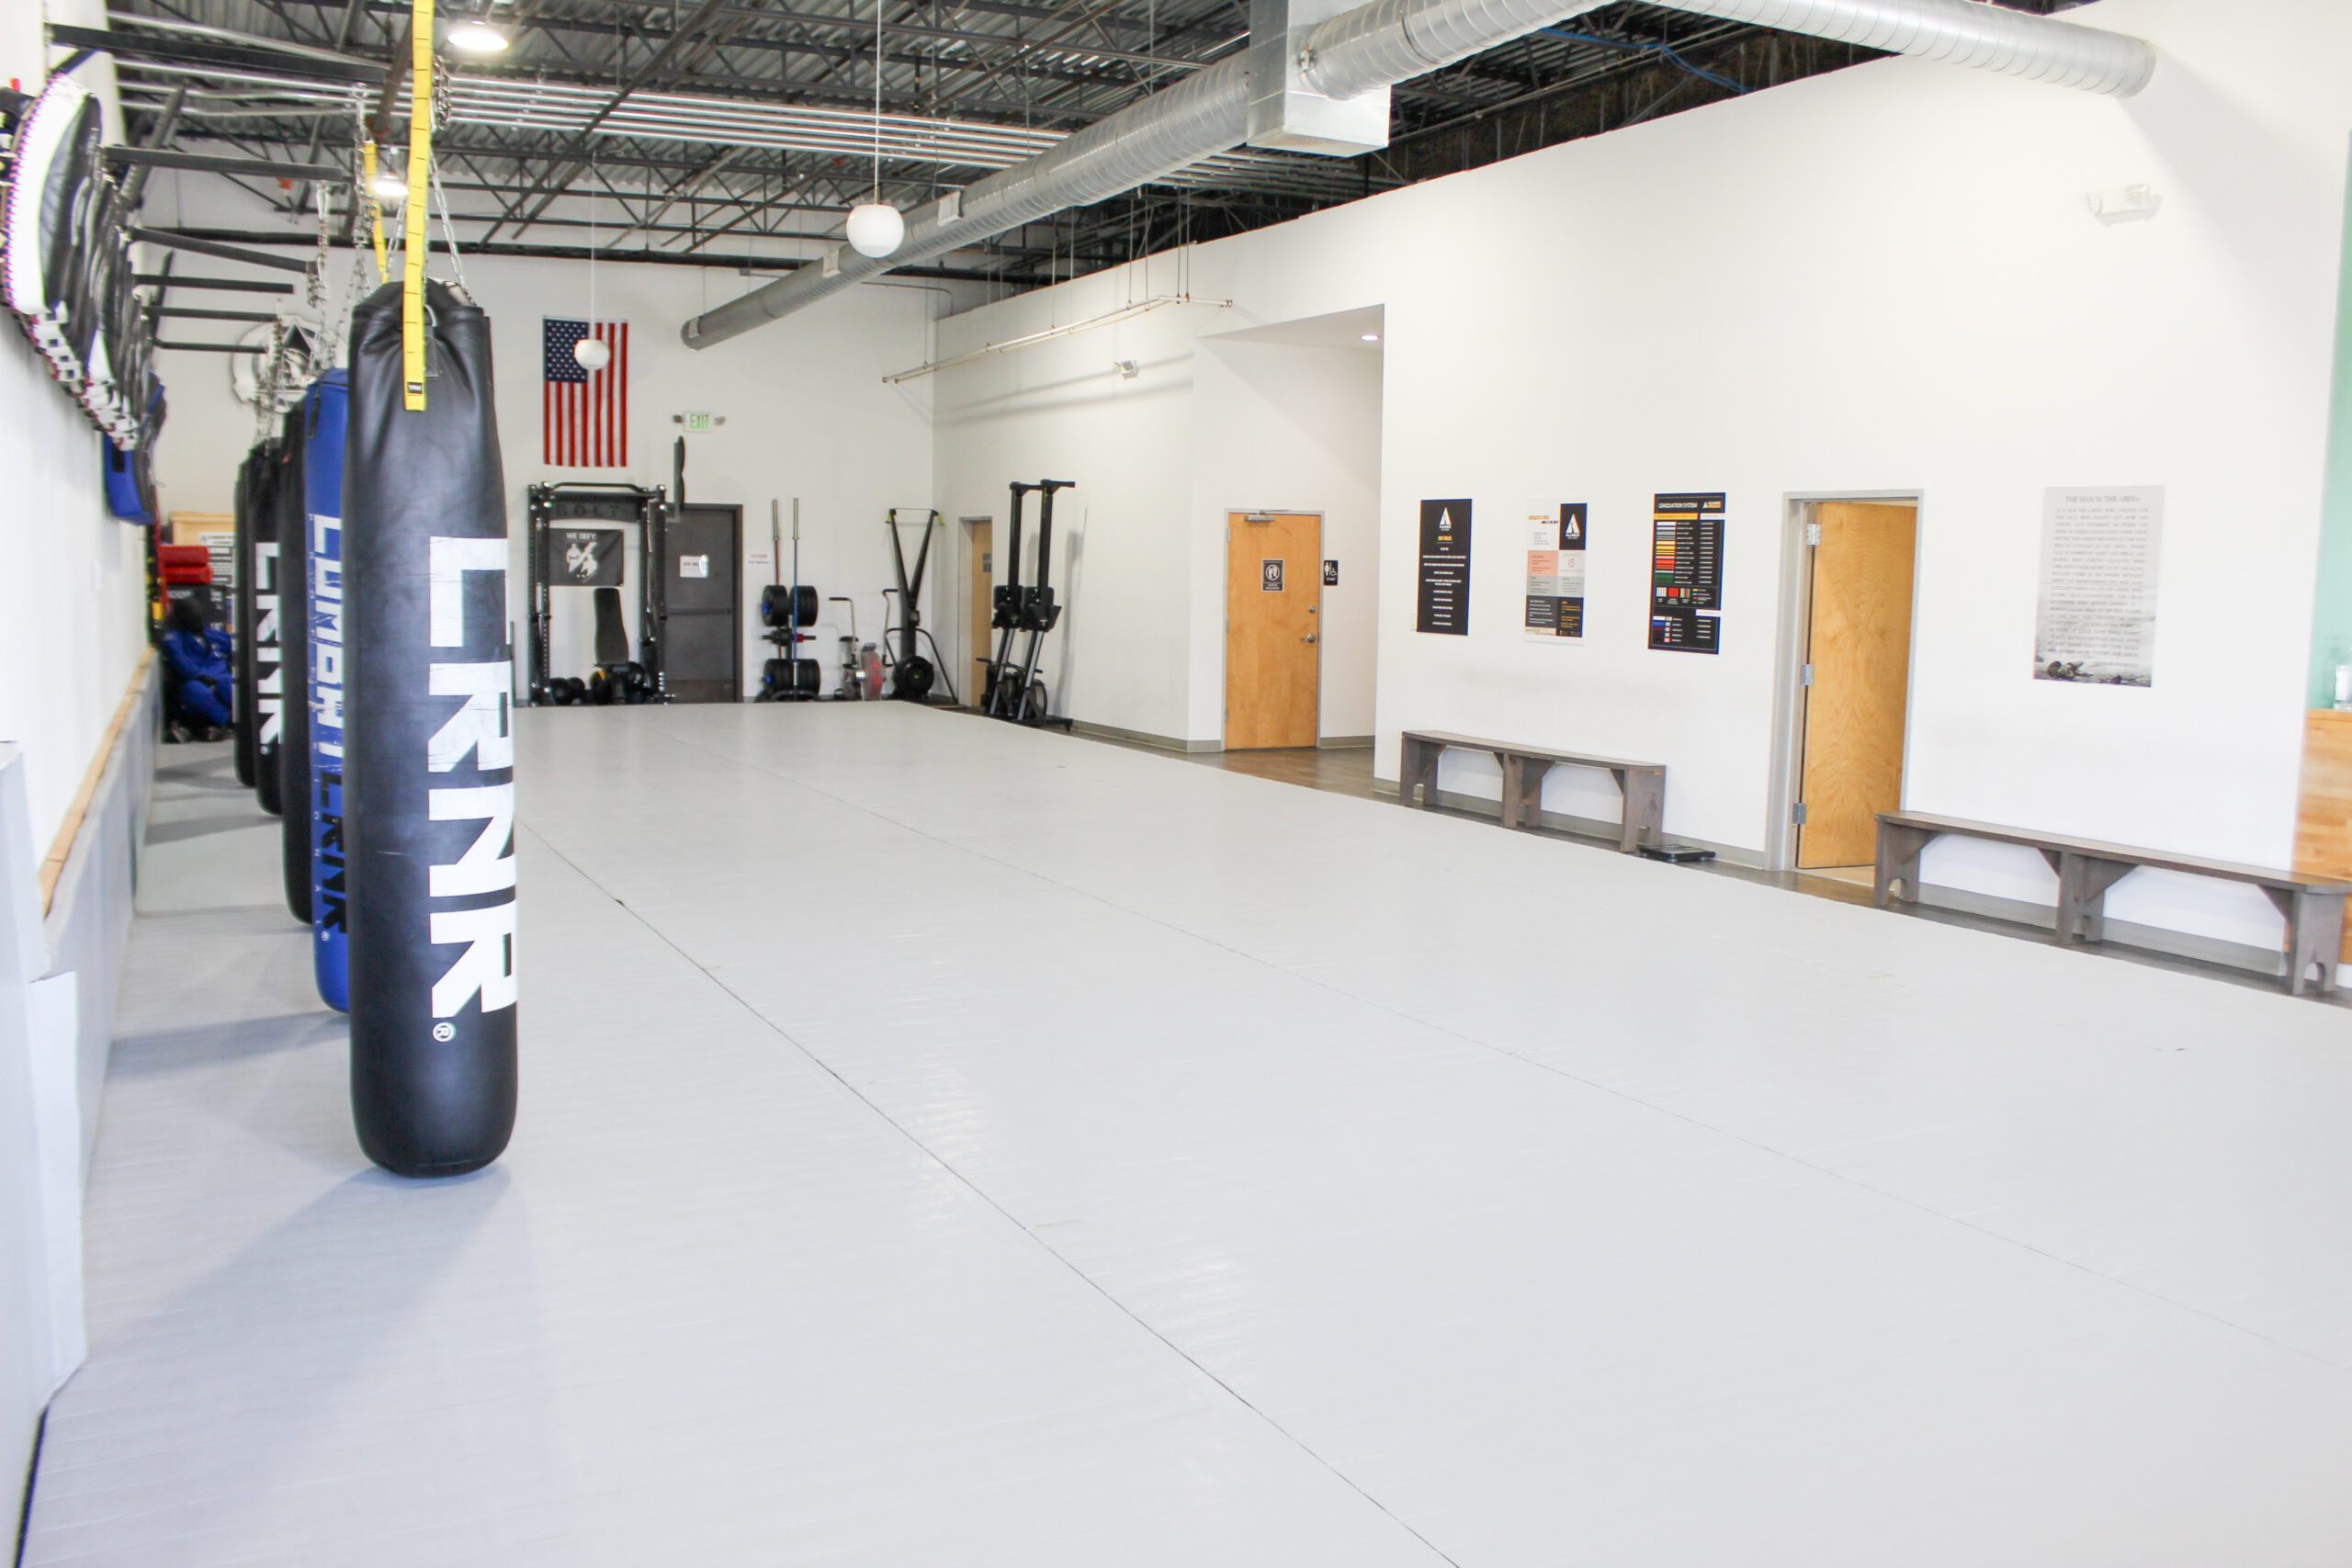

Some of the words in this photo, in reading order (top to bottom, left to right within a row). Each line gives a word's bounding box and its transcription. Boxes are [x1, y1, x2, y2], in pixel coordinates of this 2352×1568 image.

[690, 413, 710, 430] EXIT
[557, 502, 621, 517] BOLT
[579, 532, 596, 540] DEFY
